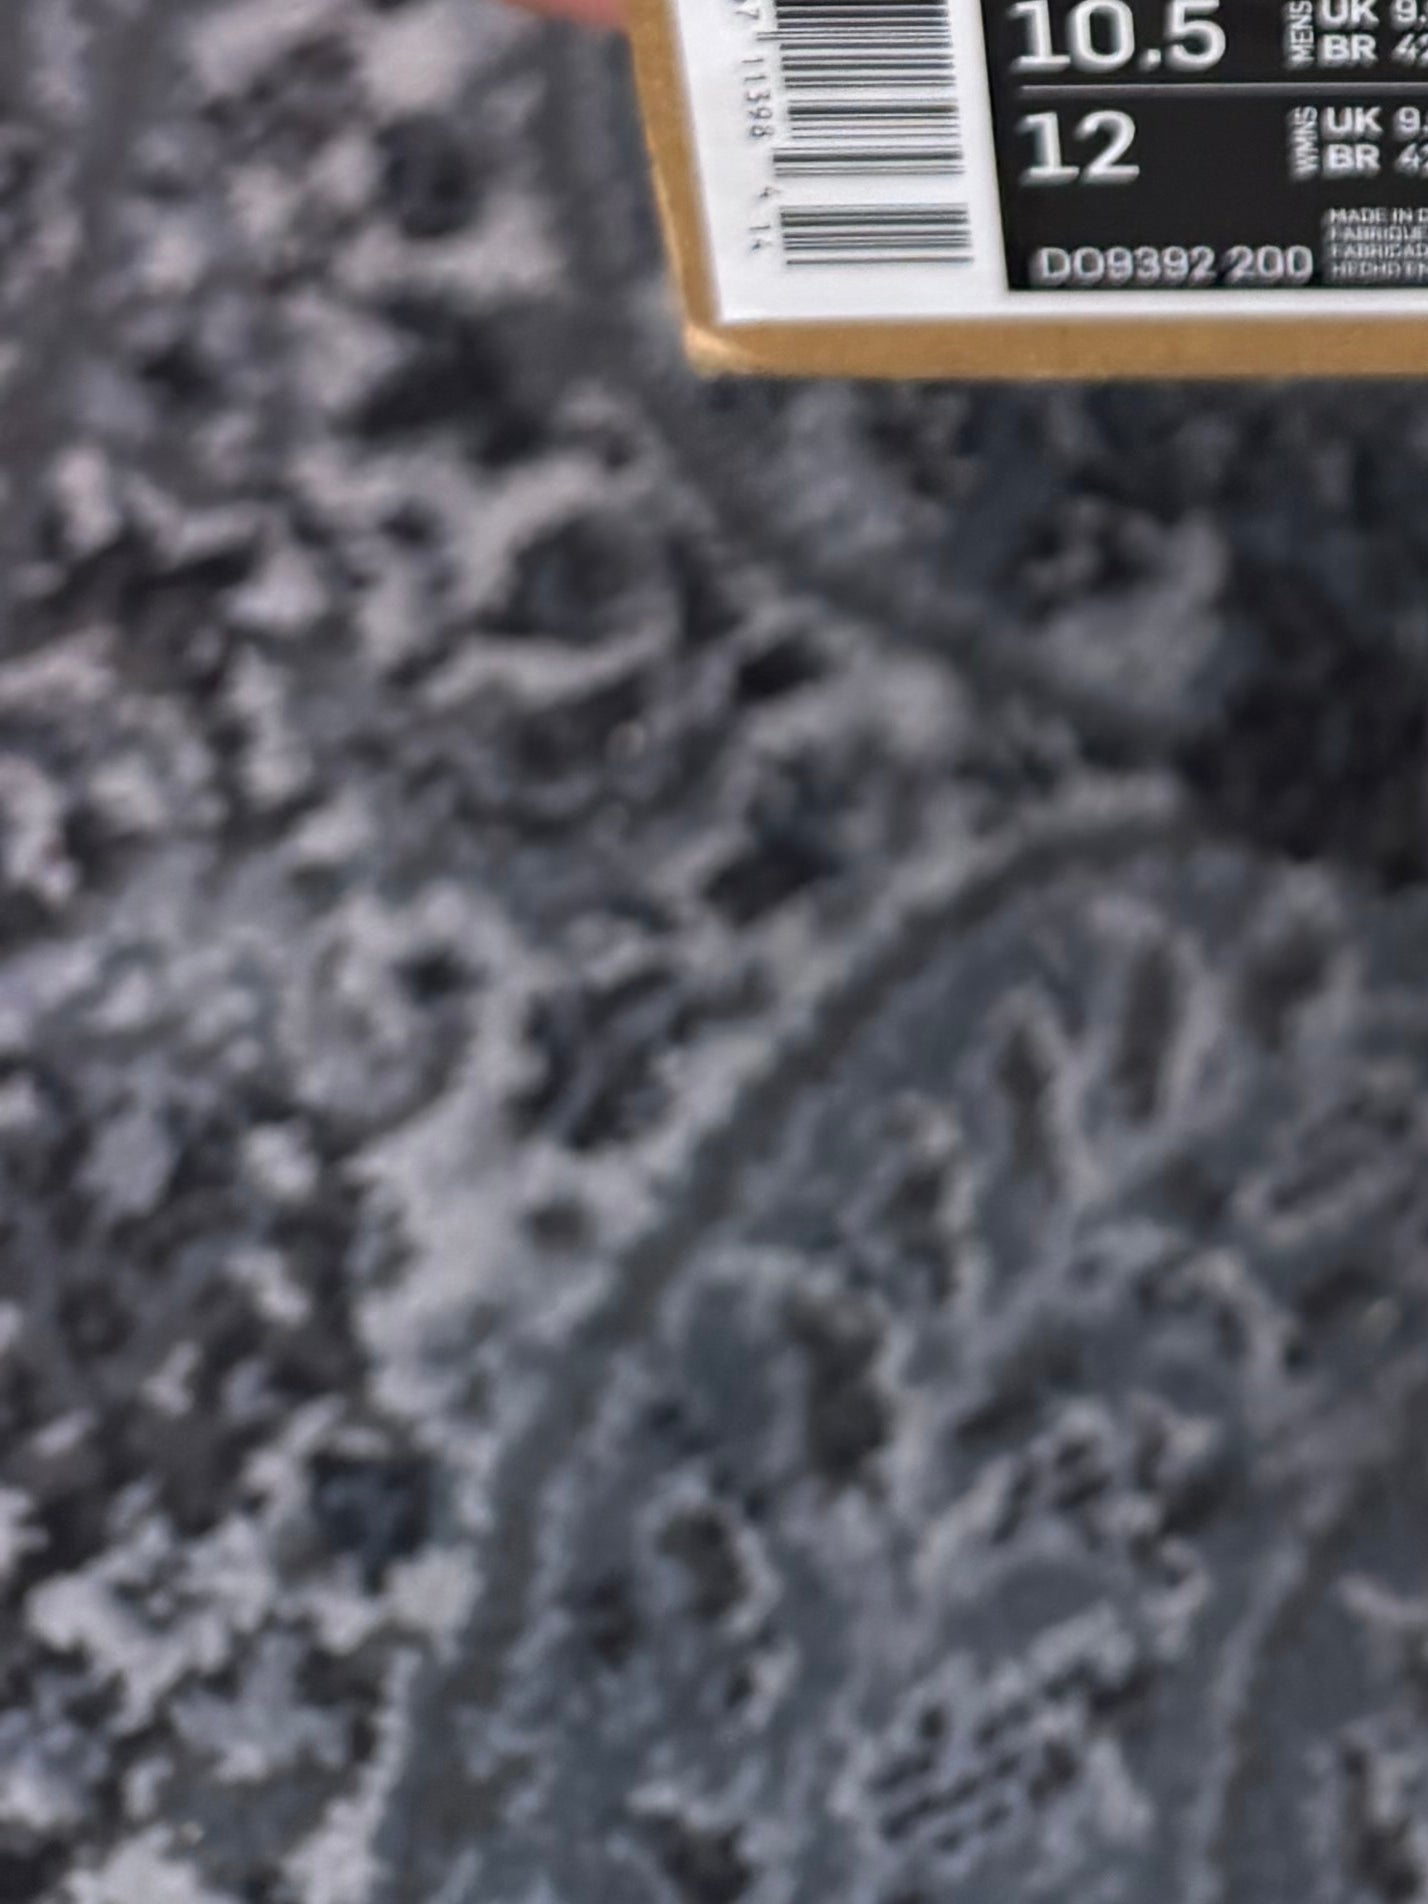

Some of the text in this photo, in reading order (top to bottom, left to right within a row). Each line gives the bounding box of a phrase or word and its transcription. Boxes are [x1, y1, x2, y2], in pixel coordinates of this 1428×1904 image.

[1287, 0, 1313, 65] MENS
[1319, 33, 1377, 66] BR
[740, 56, 776, 141] 11398
[1322, 106, 1381, 136] UK
[1015, 110, 1140, 184] 12
[1291, 105, 1318, 175] WMNS
[1322, 143, 1380, 175] BR
[1327, 206, 1386, 224] MADE
[1222, 245, 1313, 282] 200
